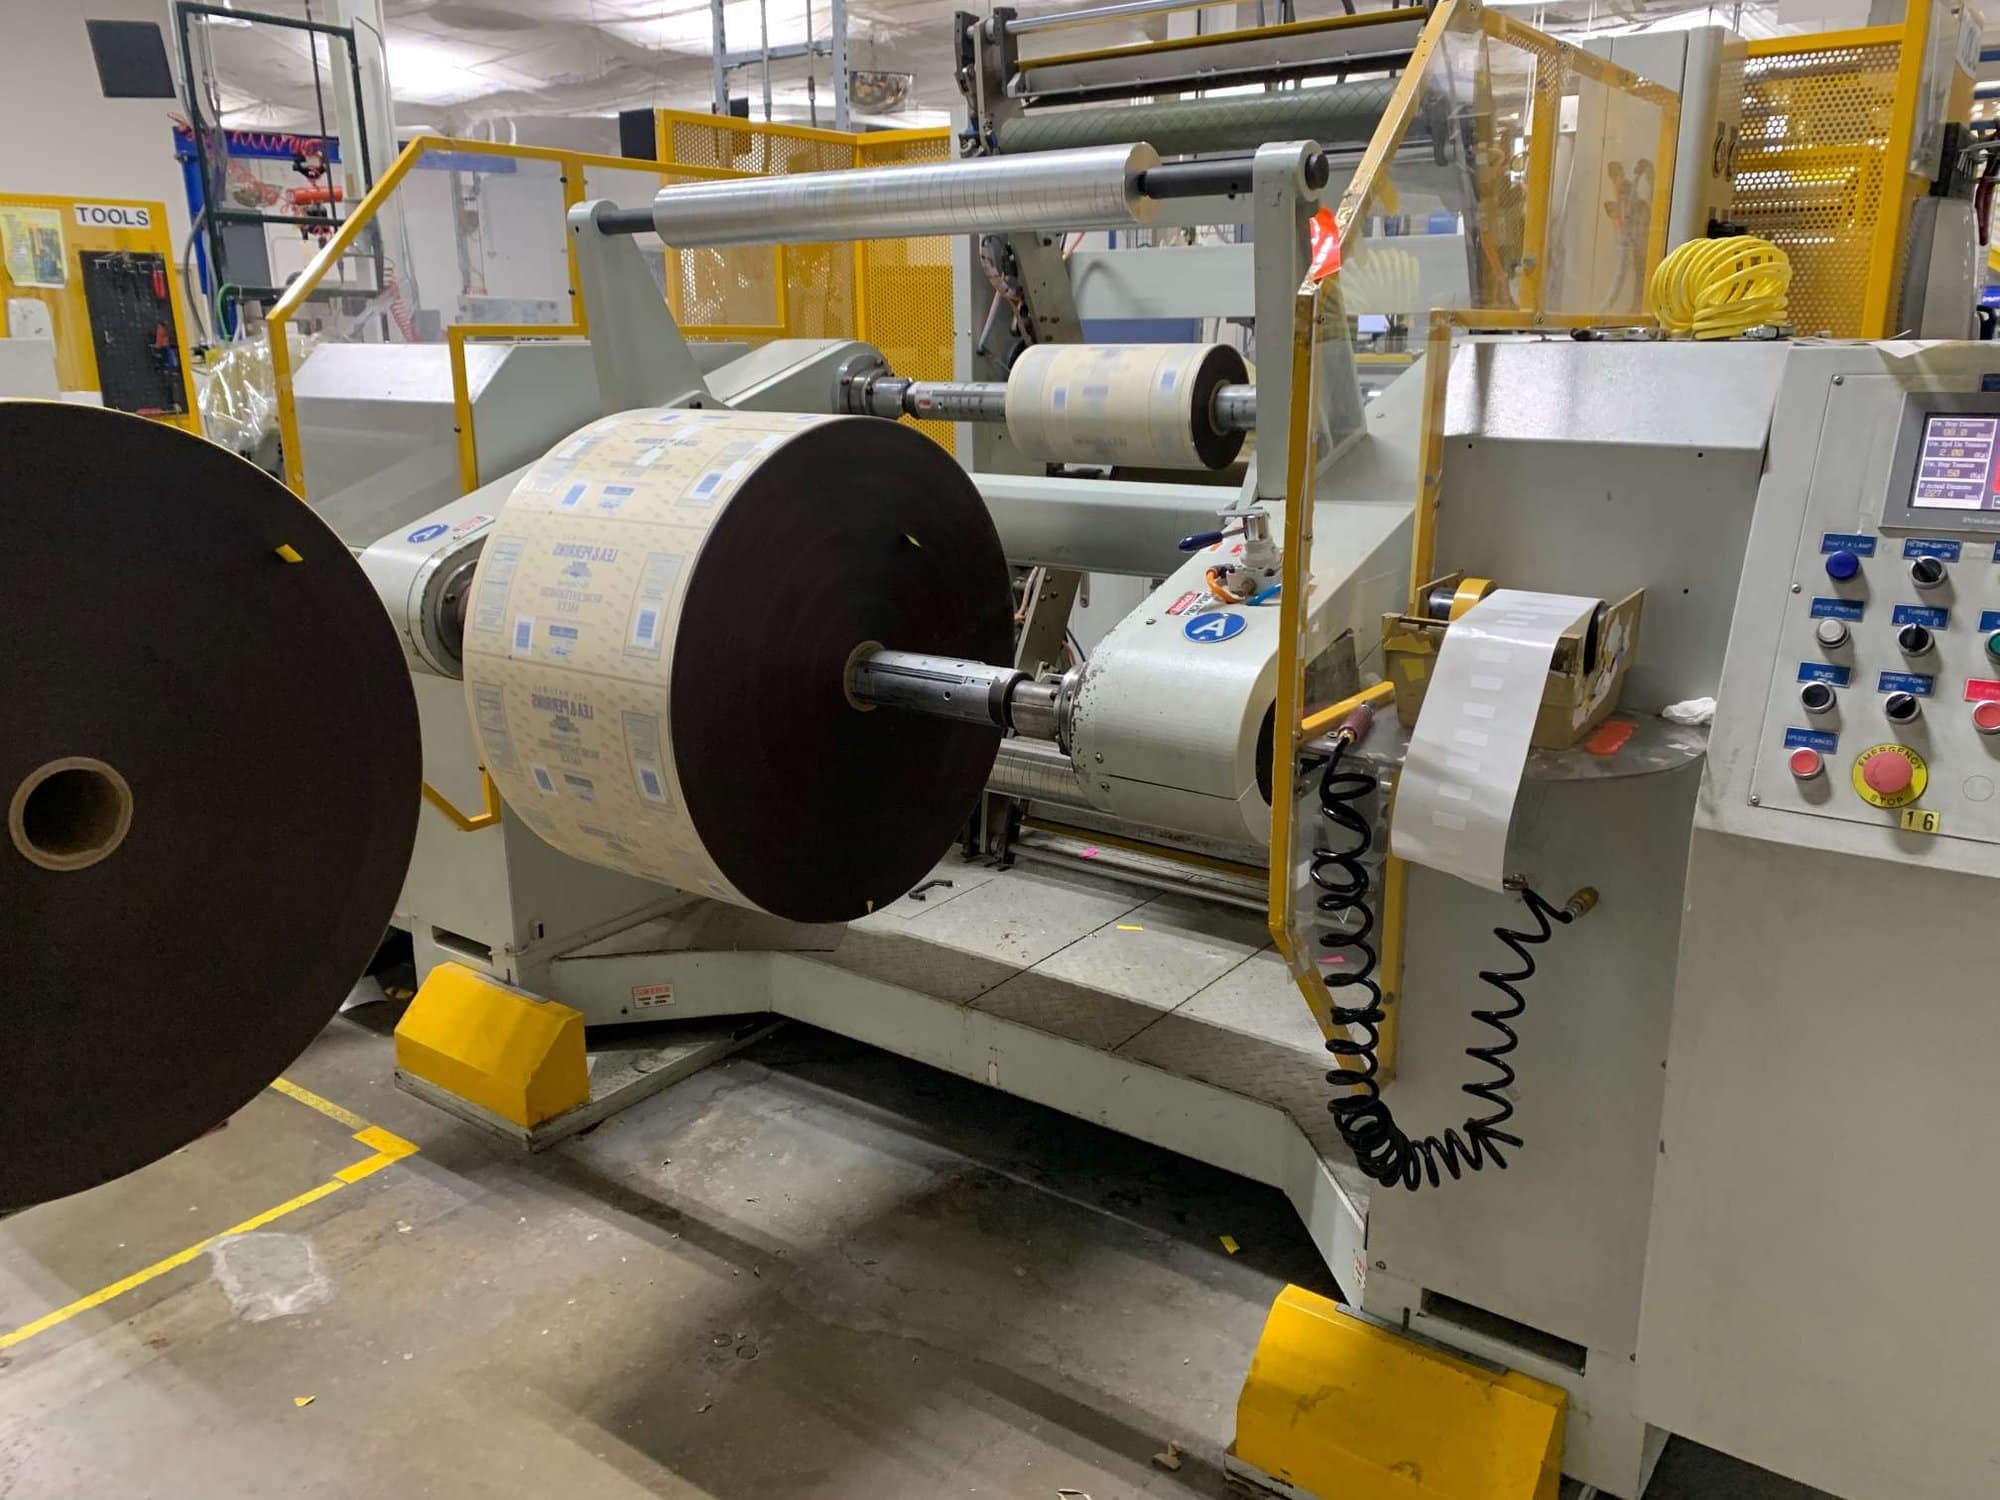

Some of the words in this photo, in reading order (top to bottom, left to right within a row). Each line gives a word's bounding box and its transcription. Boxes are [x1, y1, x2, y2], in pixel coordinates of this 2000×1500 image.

[76, 206, 149, 226] TOOLS
[1191, 618, 1227, 637] A
[1858, 745, 1923, 769] EMERGENCY
[1870, 794, 1904, 806] STOP
